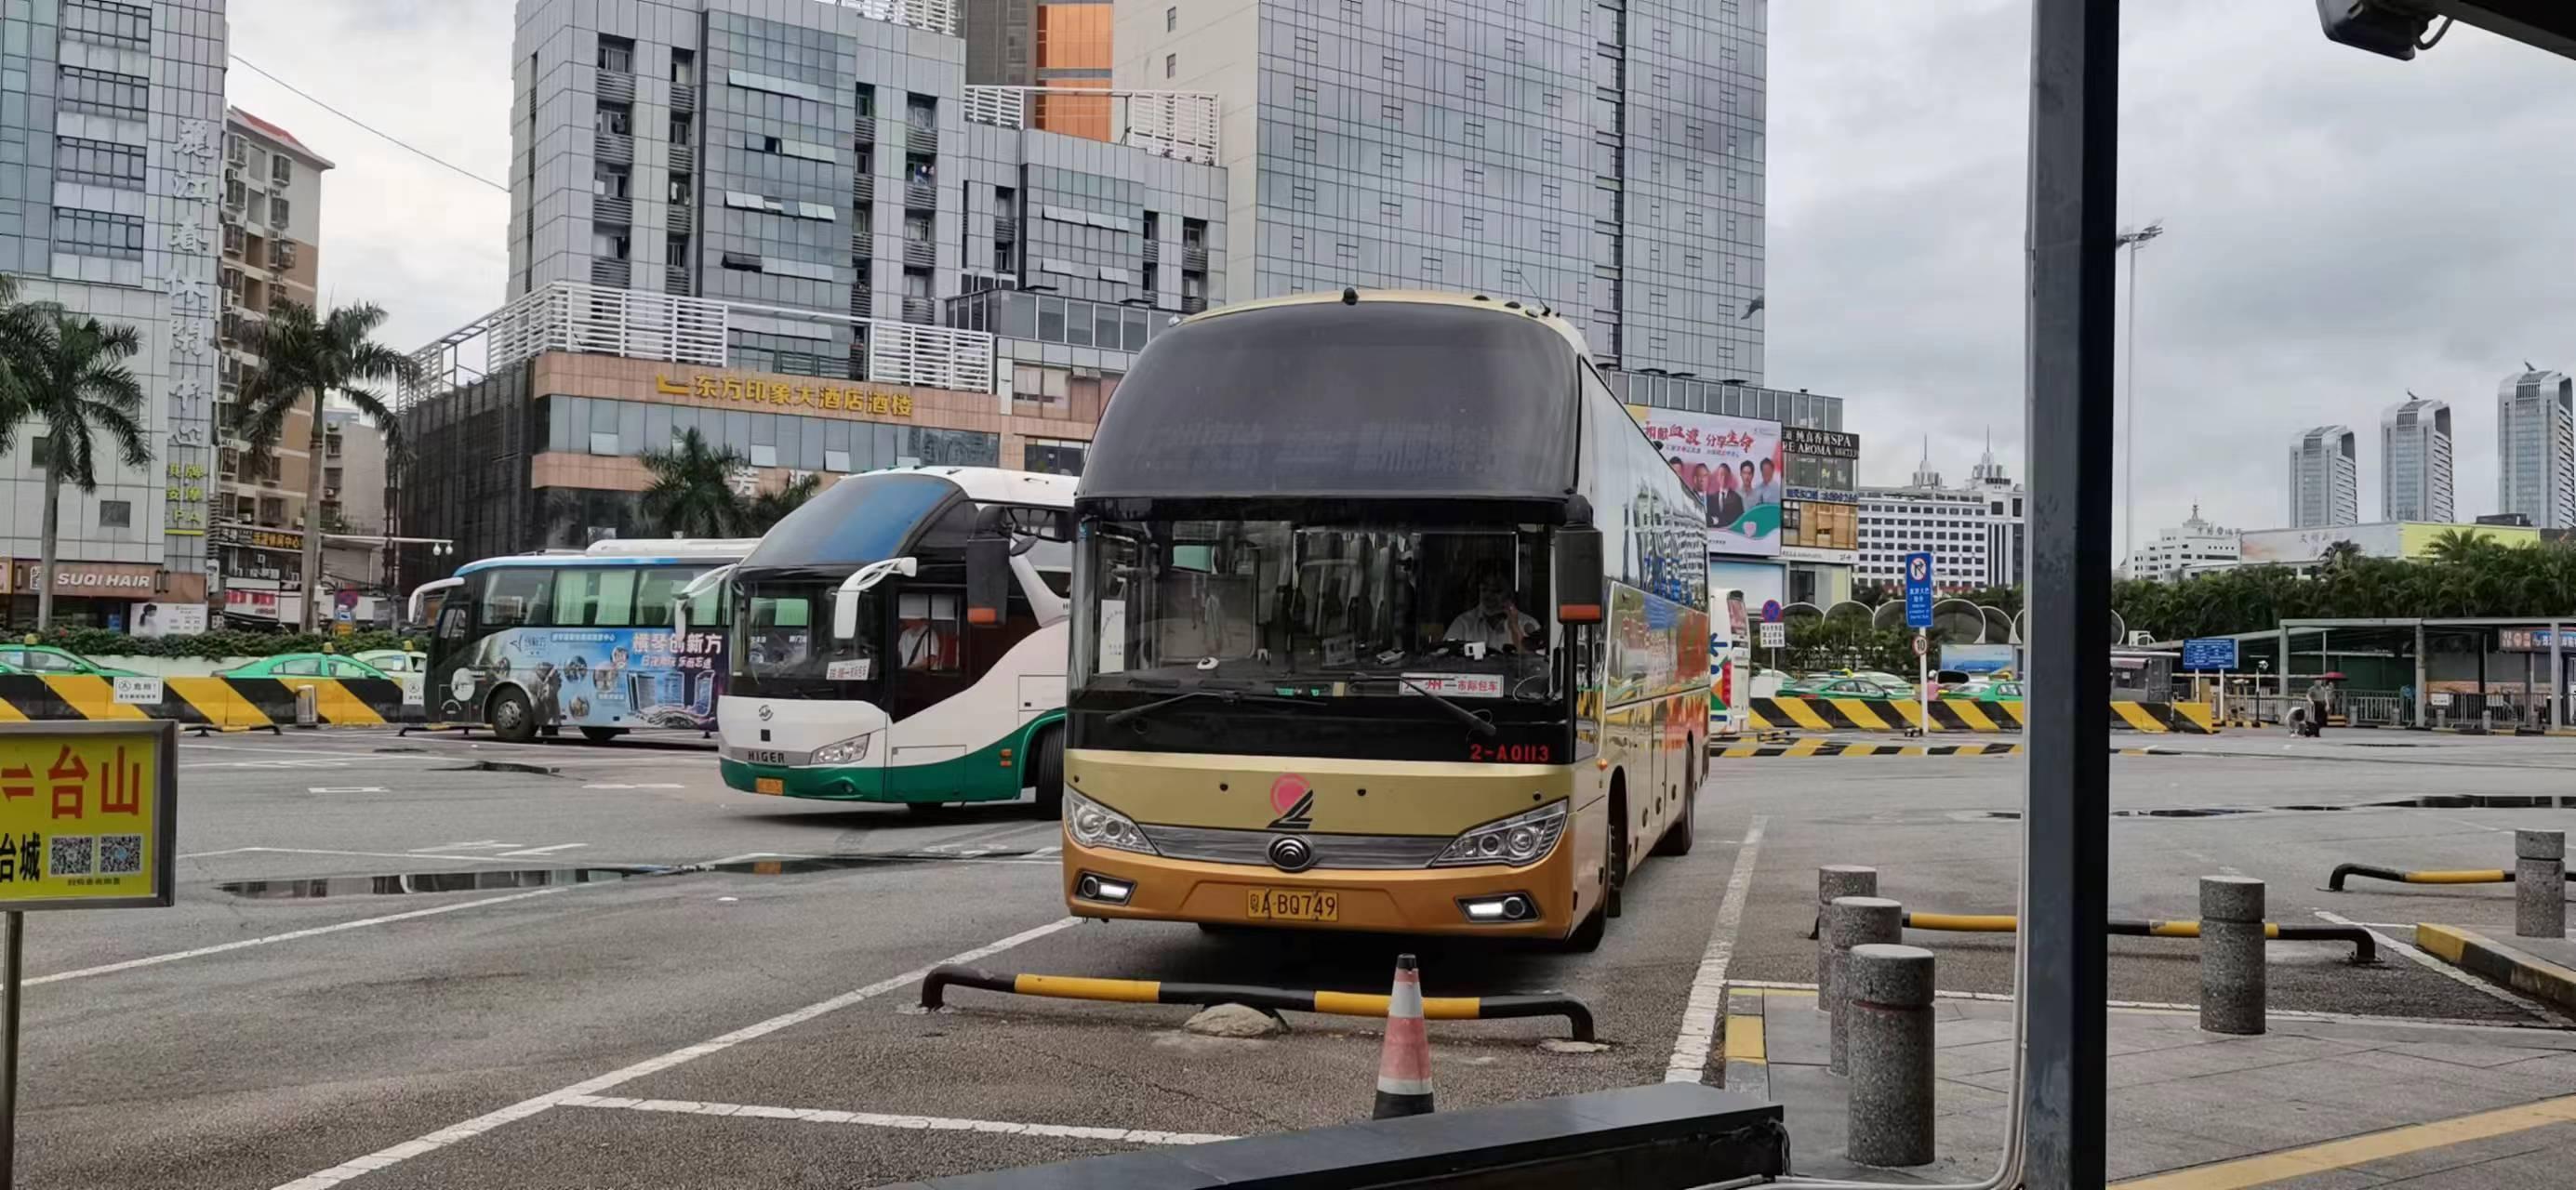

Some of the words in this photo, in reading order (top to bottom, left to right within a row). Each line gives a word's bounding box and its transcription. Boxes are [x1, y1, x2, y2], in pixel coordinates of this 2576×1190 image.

[694, 375, 915, 417] 东方印象大酒店酒楼
[1798, 443, 1831, 456] AROMA
[58, 573, 103, 586] SUQI
[105, 574, 150, 587] HAIR
[748, 750, 785, 763] HIGER
[1469, 744, 1549, 761] 2-A0113
[47, 745, 141, 820] 台山
[0, 832, 41, 883] 台城
